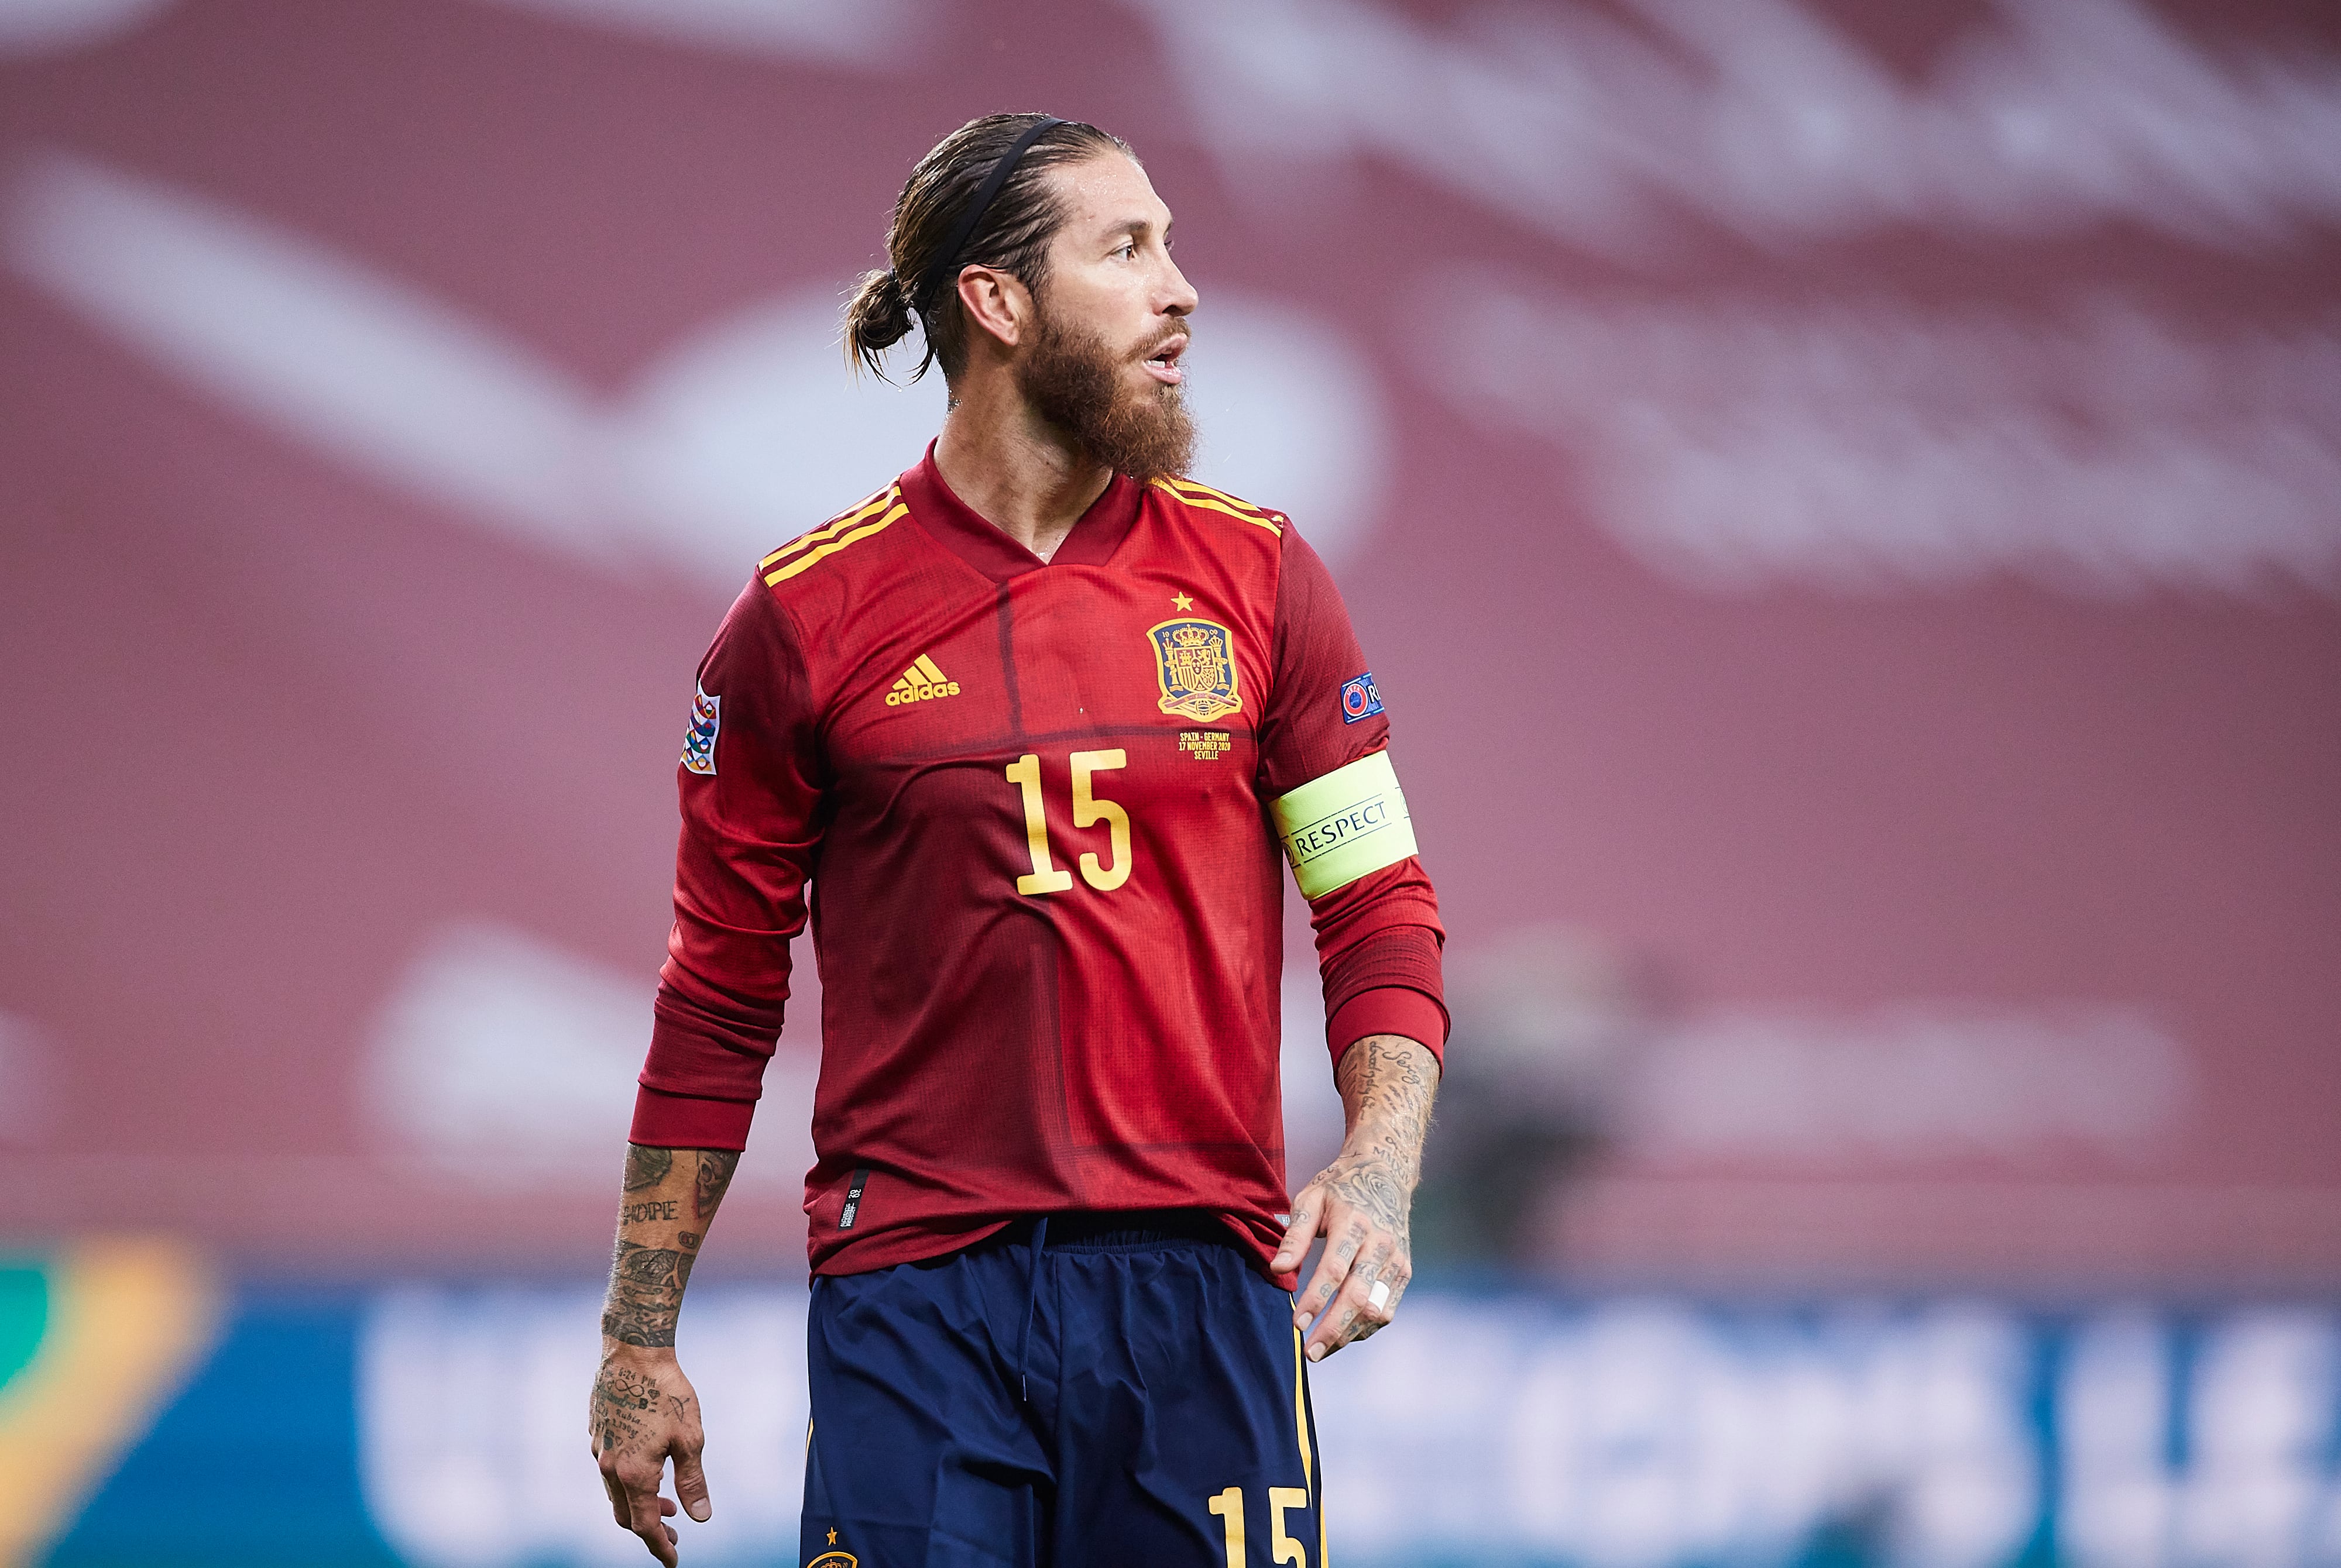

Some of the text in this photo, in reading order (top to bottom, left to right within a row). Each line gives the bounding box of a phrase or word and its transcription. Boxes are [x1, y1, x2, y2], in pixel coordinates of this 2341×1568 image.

[885, 682, 960, 706] adidas
[1347, 685, 1360, 696] UEFA
[1179, 741, 1231, 751] 17 NOVEMBER 2020
[1180, 732, 1200, 742] SPAIN
[1204, 732, 1230, 742] GERMANY
[1194, 751, 1218, 760] SEVILLE
[1005, 748, 1132, 895] 15
[1295, 801, 1385, 857] RESPECT
[623, 1201, 678, 1226] HOPE
[1208, 1487, 1307, 1568] 15
